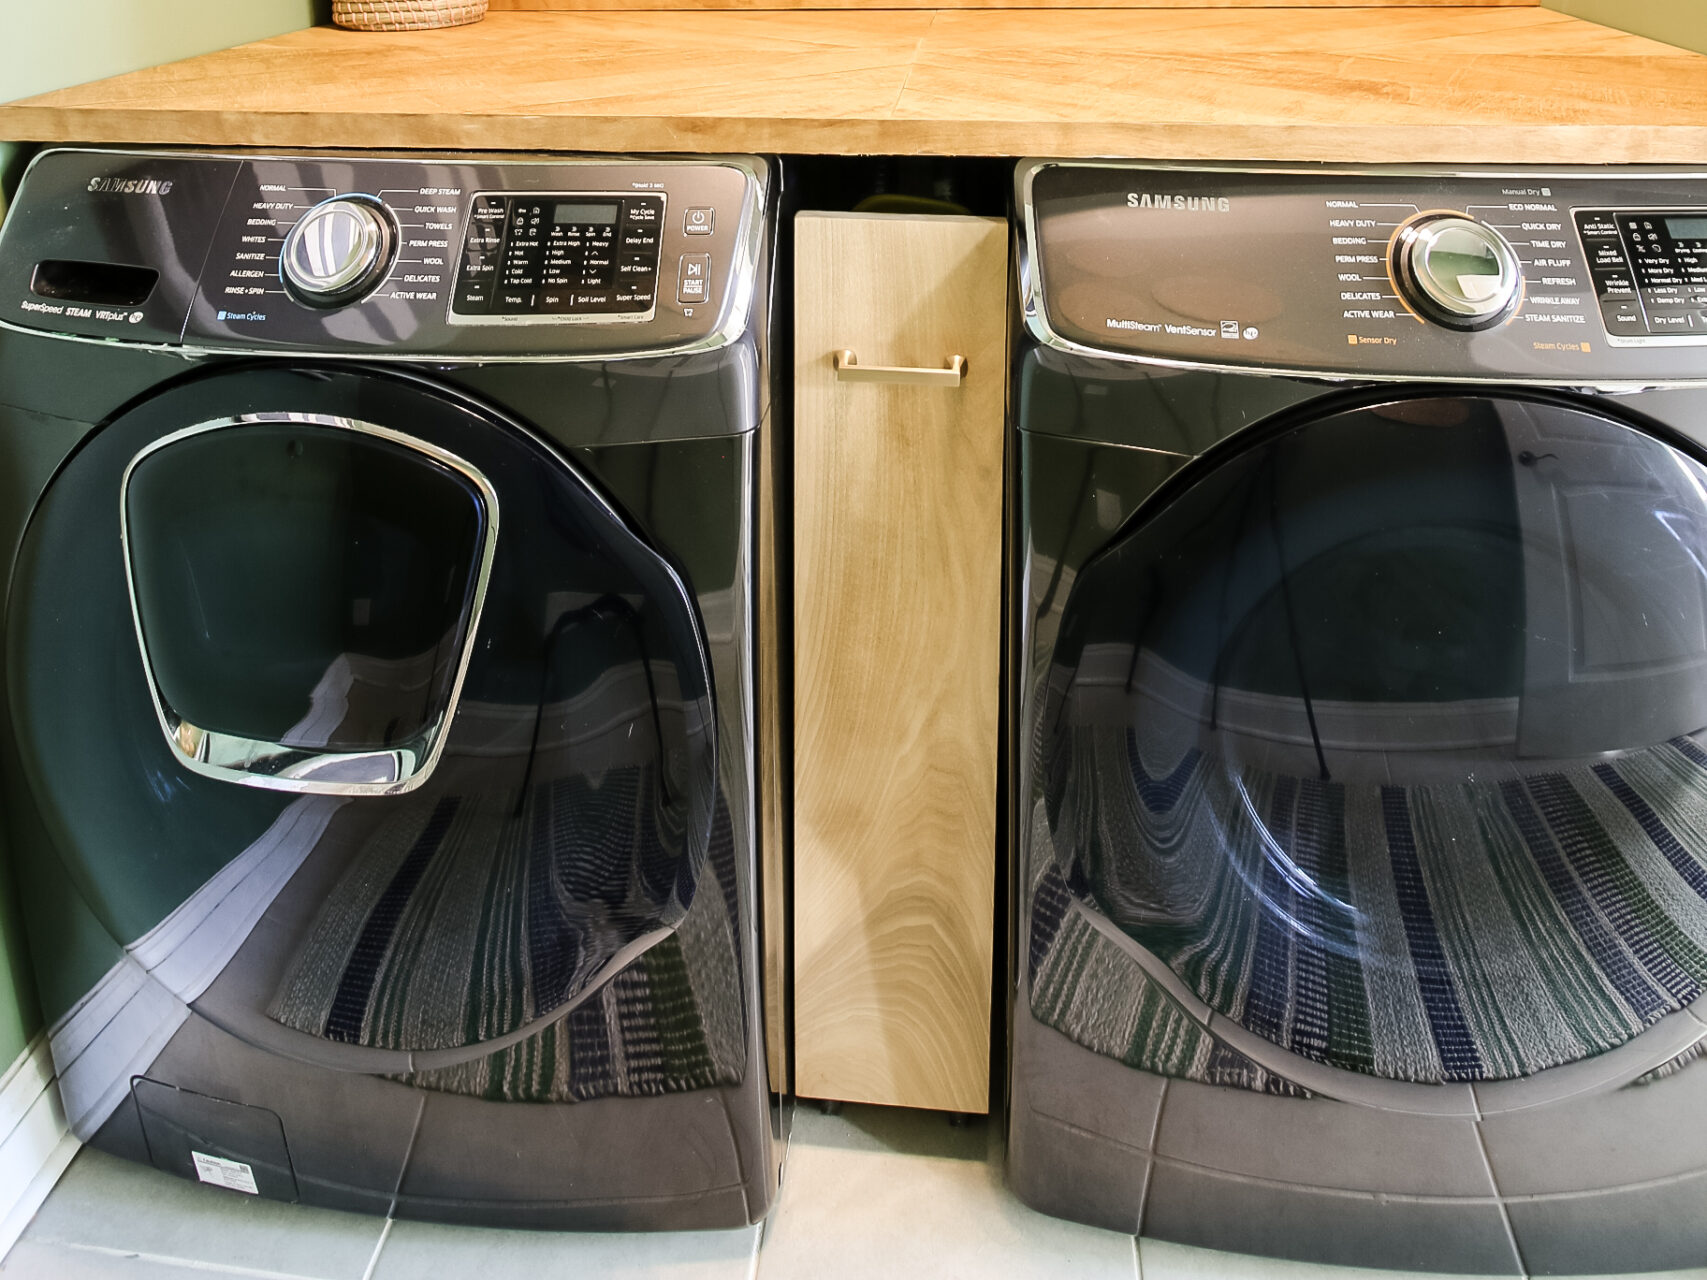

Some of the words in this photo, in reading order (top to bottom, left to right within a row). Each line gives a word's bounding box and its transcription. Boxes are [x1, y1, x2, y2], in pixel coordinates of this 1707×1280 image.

[88, 177, 173, 195] SAMSUNG
[1127, 192, 1230, 213] SAMSUNG
[1550, 240, 1566, 248] DRY
[1548, 259, 1571, 267] FLUFF
[1561, 296, 1580, 304] AWAY
[21, 300, 64, 314] SuperSpeed
[66, 307, 92, 318] STEAM
[246, 313, 266, 321] Cycles
[1552, 315, 1586, 323] SANITIZE
[1654, 316, 1666, 324] Dry
[1164, 324, 1216, 337] VentSensor
[1384, 336, 1396, 345] Dry
[1534, 342, 1556, 350] Steam
[1557, 342, 1580, 351] Cycles
